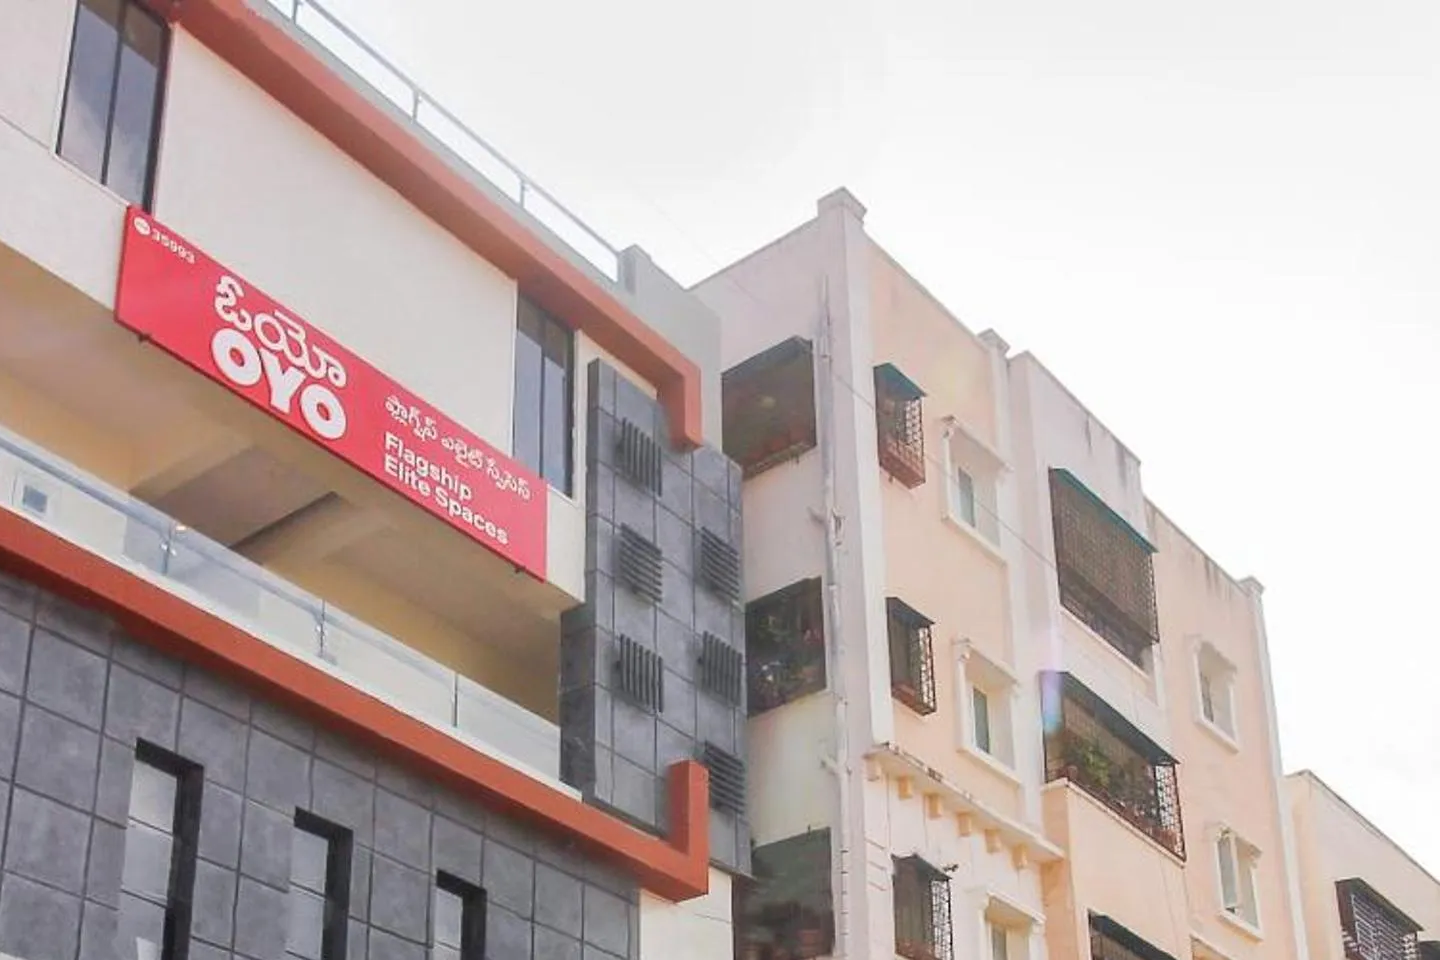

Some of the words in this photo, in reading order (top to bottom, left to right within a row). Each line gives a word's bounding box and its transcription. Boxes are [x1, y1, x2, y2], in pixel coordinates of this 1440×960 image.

[211, 328, 347, 440] OYO
[384, 454, 431, 497] Elite
[435, 486, 508, 544] Spaces
[385, 431, 472, 501] Flagship
